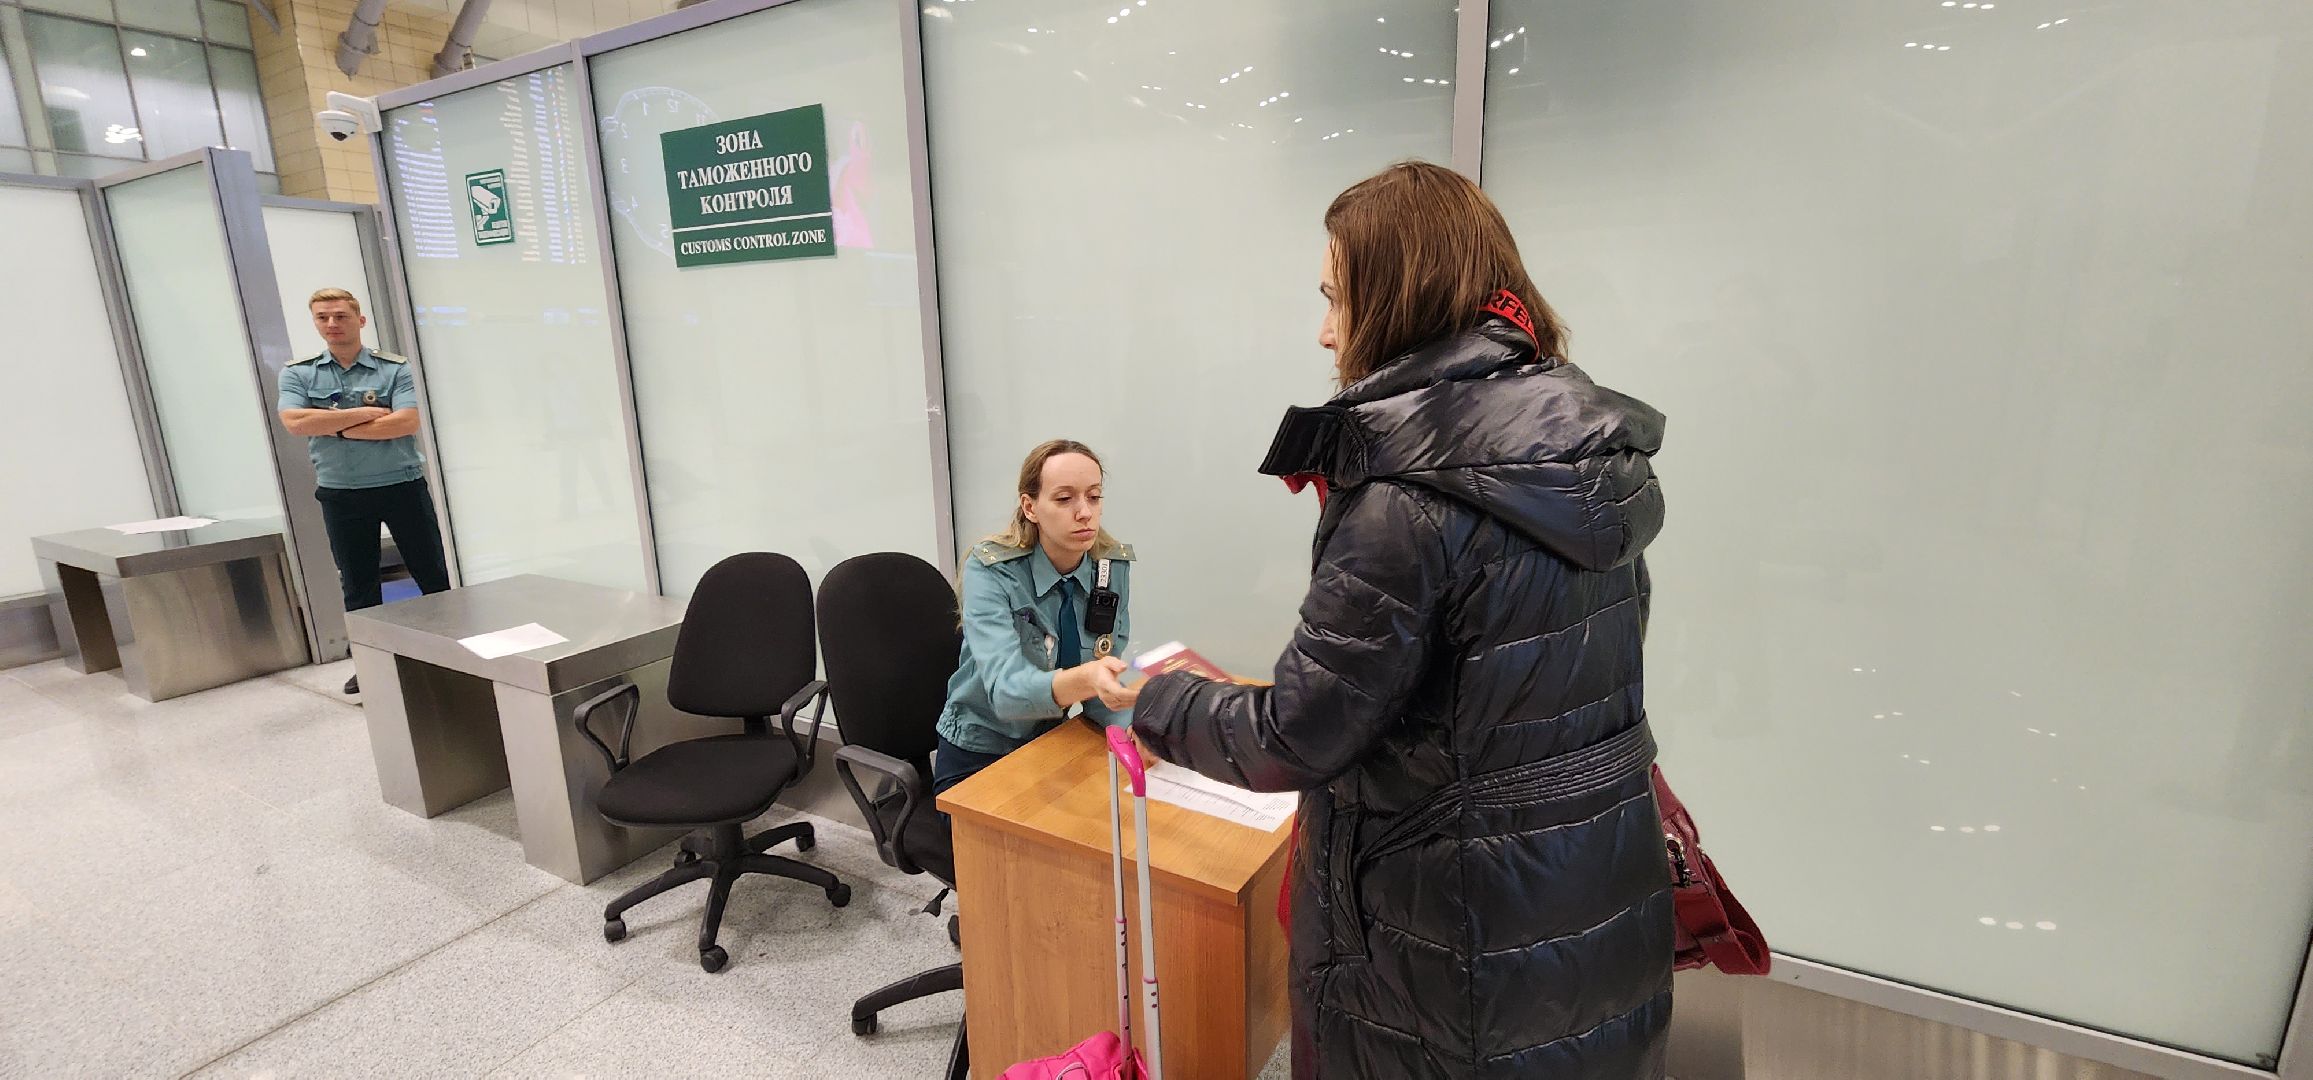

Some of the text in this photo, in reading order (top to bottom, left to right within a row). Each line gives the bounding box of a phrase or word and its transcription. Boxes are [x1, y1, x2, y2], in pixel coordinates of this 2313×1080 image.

[715, 129, 764, 155] ЗОНА
[677, 152, 813, 190] ТАМОЖЕННОГО
[700, 185, 794, 215] КОНТРОЛЯ
[680, 228, 827, 256] CUSTOMS CONTROL ZONE
